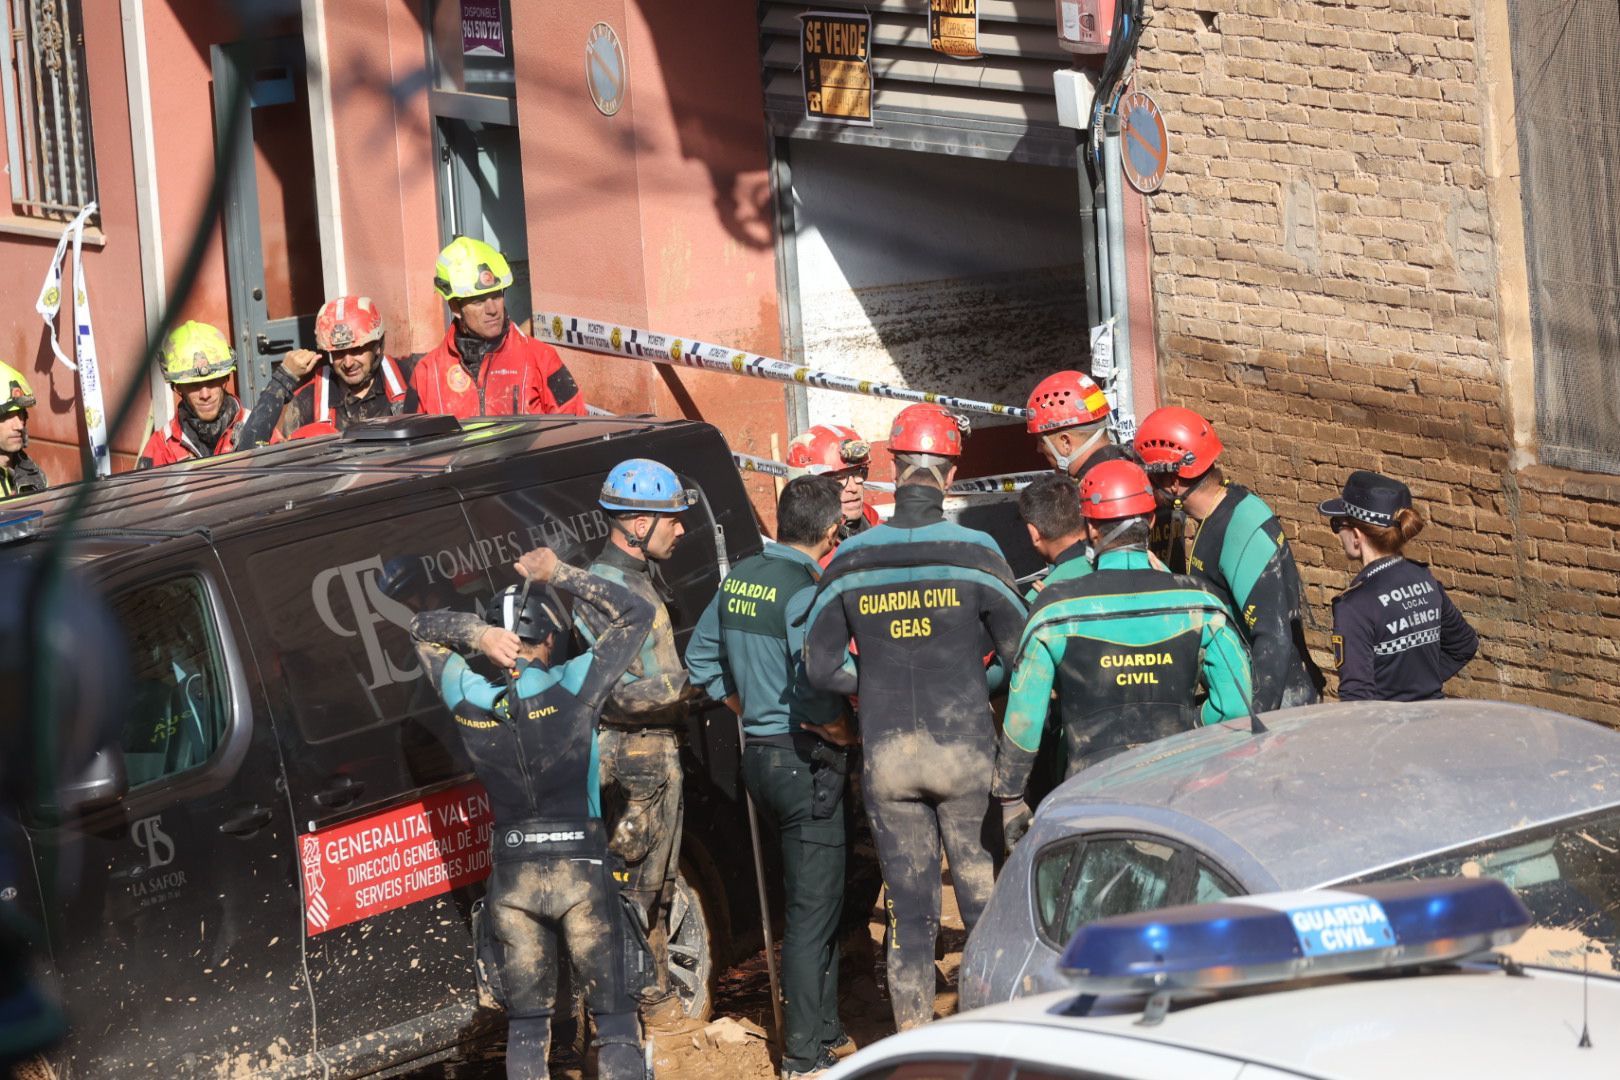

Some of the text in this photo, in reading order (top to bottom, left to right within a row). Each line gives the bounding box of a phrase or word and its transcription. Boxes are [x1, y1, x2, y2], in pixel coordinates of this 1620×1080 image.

[464, 6, 497, 19] DISPONIBLE
[806, 21, 866, 57] SE VENDE
[419, 509, 611, 585] POMPES FÚNEB
[724, 578, 777, 603] GUARDIA
[859, 587, 960, 615] GUARDIA CIVIL
[1378, 581, 1434, 607] POLICIA
[1402, 597, 1428, 610] LOCAL
[728, 597, 757, 617] CIVIL
[890, 617, 931, 639] GEAS
[1100, 653, 1173, 668] GUARDIA
[1116, 672, 1159, 686] CIVIL
[455, 714, 499, 729] GUARDIA
[528, 705, 559, 720] CIVIL
[325, 810, 433, 864] GENERALITAT
[347, 847, 401, 886] DIRECCIÓ
[403, 837, 456, 868] GENERAL
[457, 829, 472, 850] DE
[132, 870, 187, 897] LA SAFOR
[355, 877, 402, 909] SERVEIS
[405, 858, 463, 893] FÚNEBRES
[886, 899, 901, 949] CIVIL
[1292, 903, 1387, 932] GUARDIA
[1320, 926, 1375, 951] CIVIL
